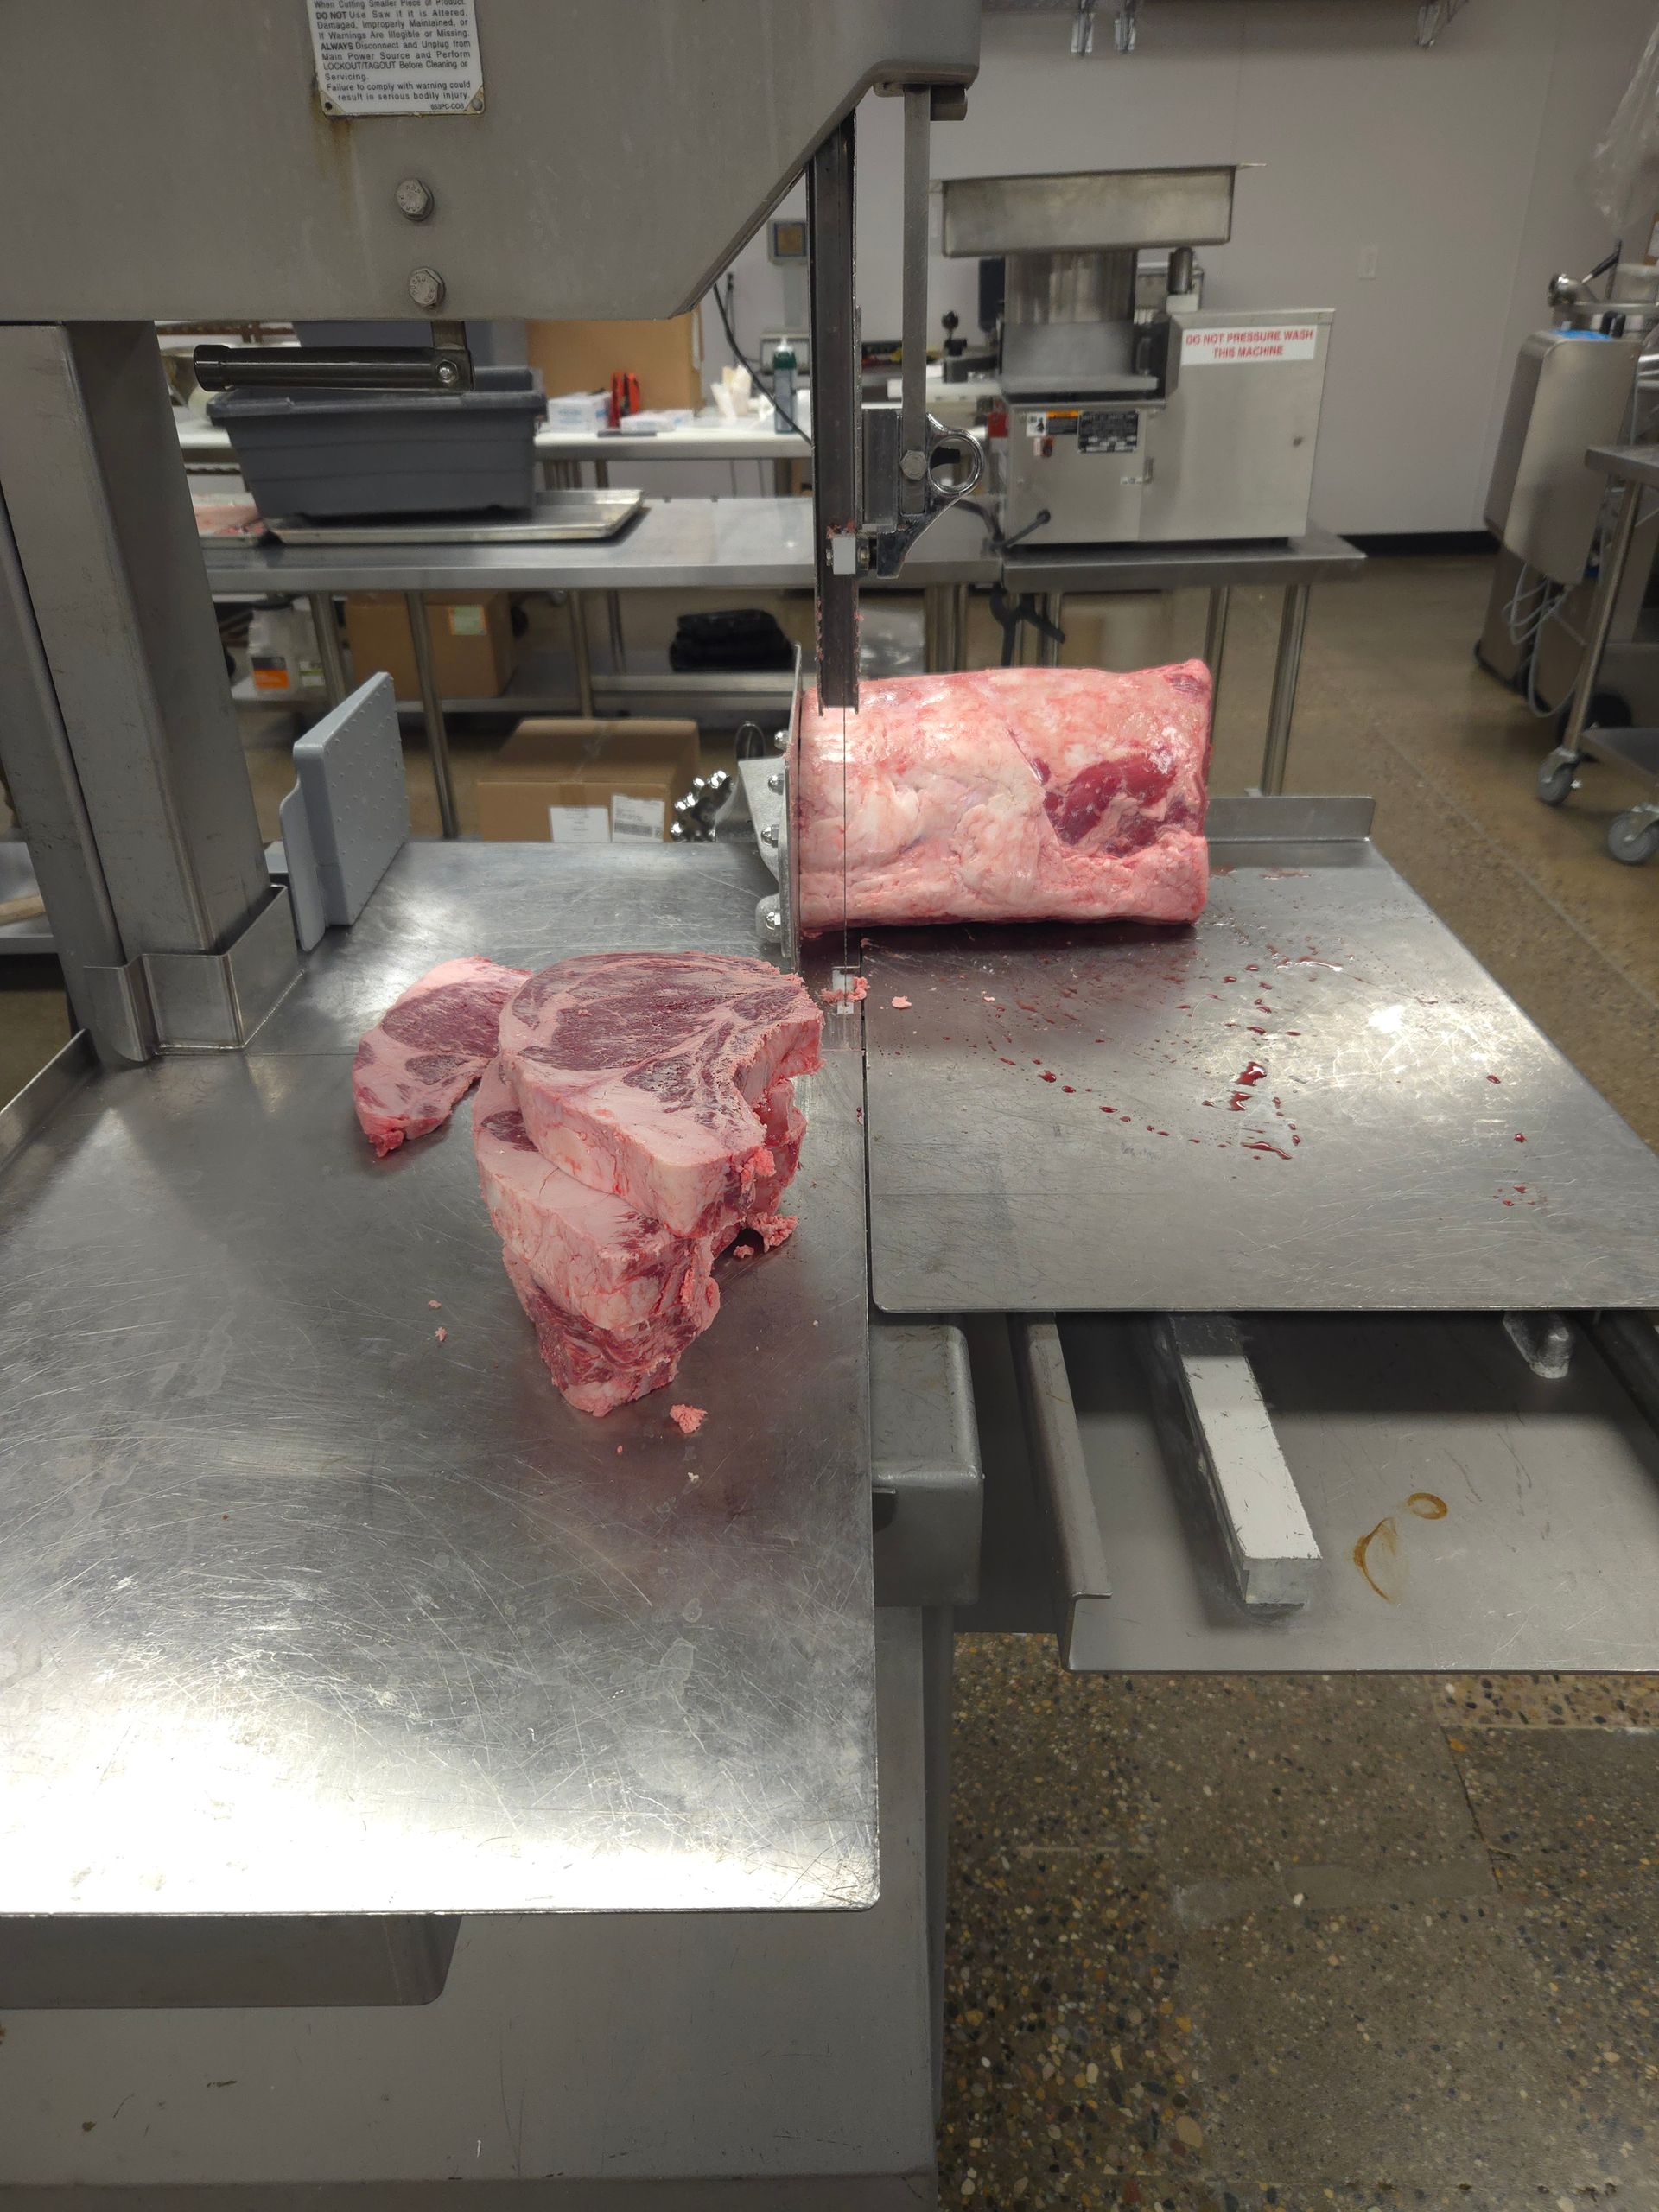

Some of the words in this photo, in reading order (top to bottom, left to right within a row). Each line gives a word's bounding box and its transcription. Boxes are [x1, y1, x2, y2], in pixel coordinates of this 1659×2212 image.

[339, 0, 365, 9] Cutting
[362, 20, 404, 29] Improperly
[328, 32, 366, 41] Warnings
[388, 30, 420, 40] Illegible
[437, 29, 470, 39] Missing.
[422, 41, 449, 49] Unplug
[323, 61, 396, 71] LOCKOUT/TAGOUT
[399, 60, 423, 69] Before
[426, 60, 457, 69] Cleaning
[325, 73, 369, 82] Servicing.
[367, 83, 395, 92] comply
[397, 81, 413, 90] with
[416, 81, 447, 90] warning
[450, 80, 471, 89] could
[414, 92, 439, 101] bodily
[443, 92, 470, 100] injury.
[1185, 334, 1200, 346] DO
[1204, 334, 1224, 344] NOT
[1227, 331, 1281, 343] PRESSURE
[1284, 329, 1313, 340] WASH
[1214, 347, 1235, 359] THIS
[1237, 345, 1284, 358] MACHINE
